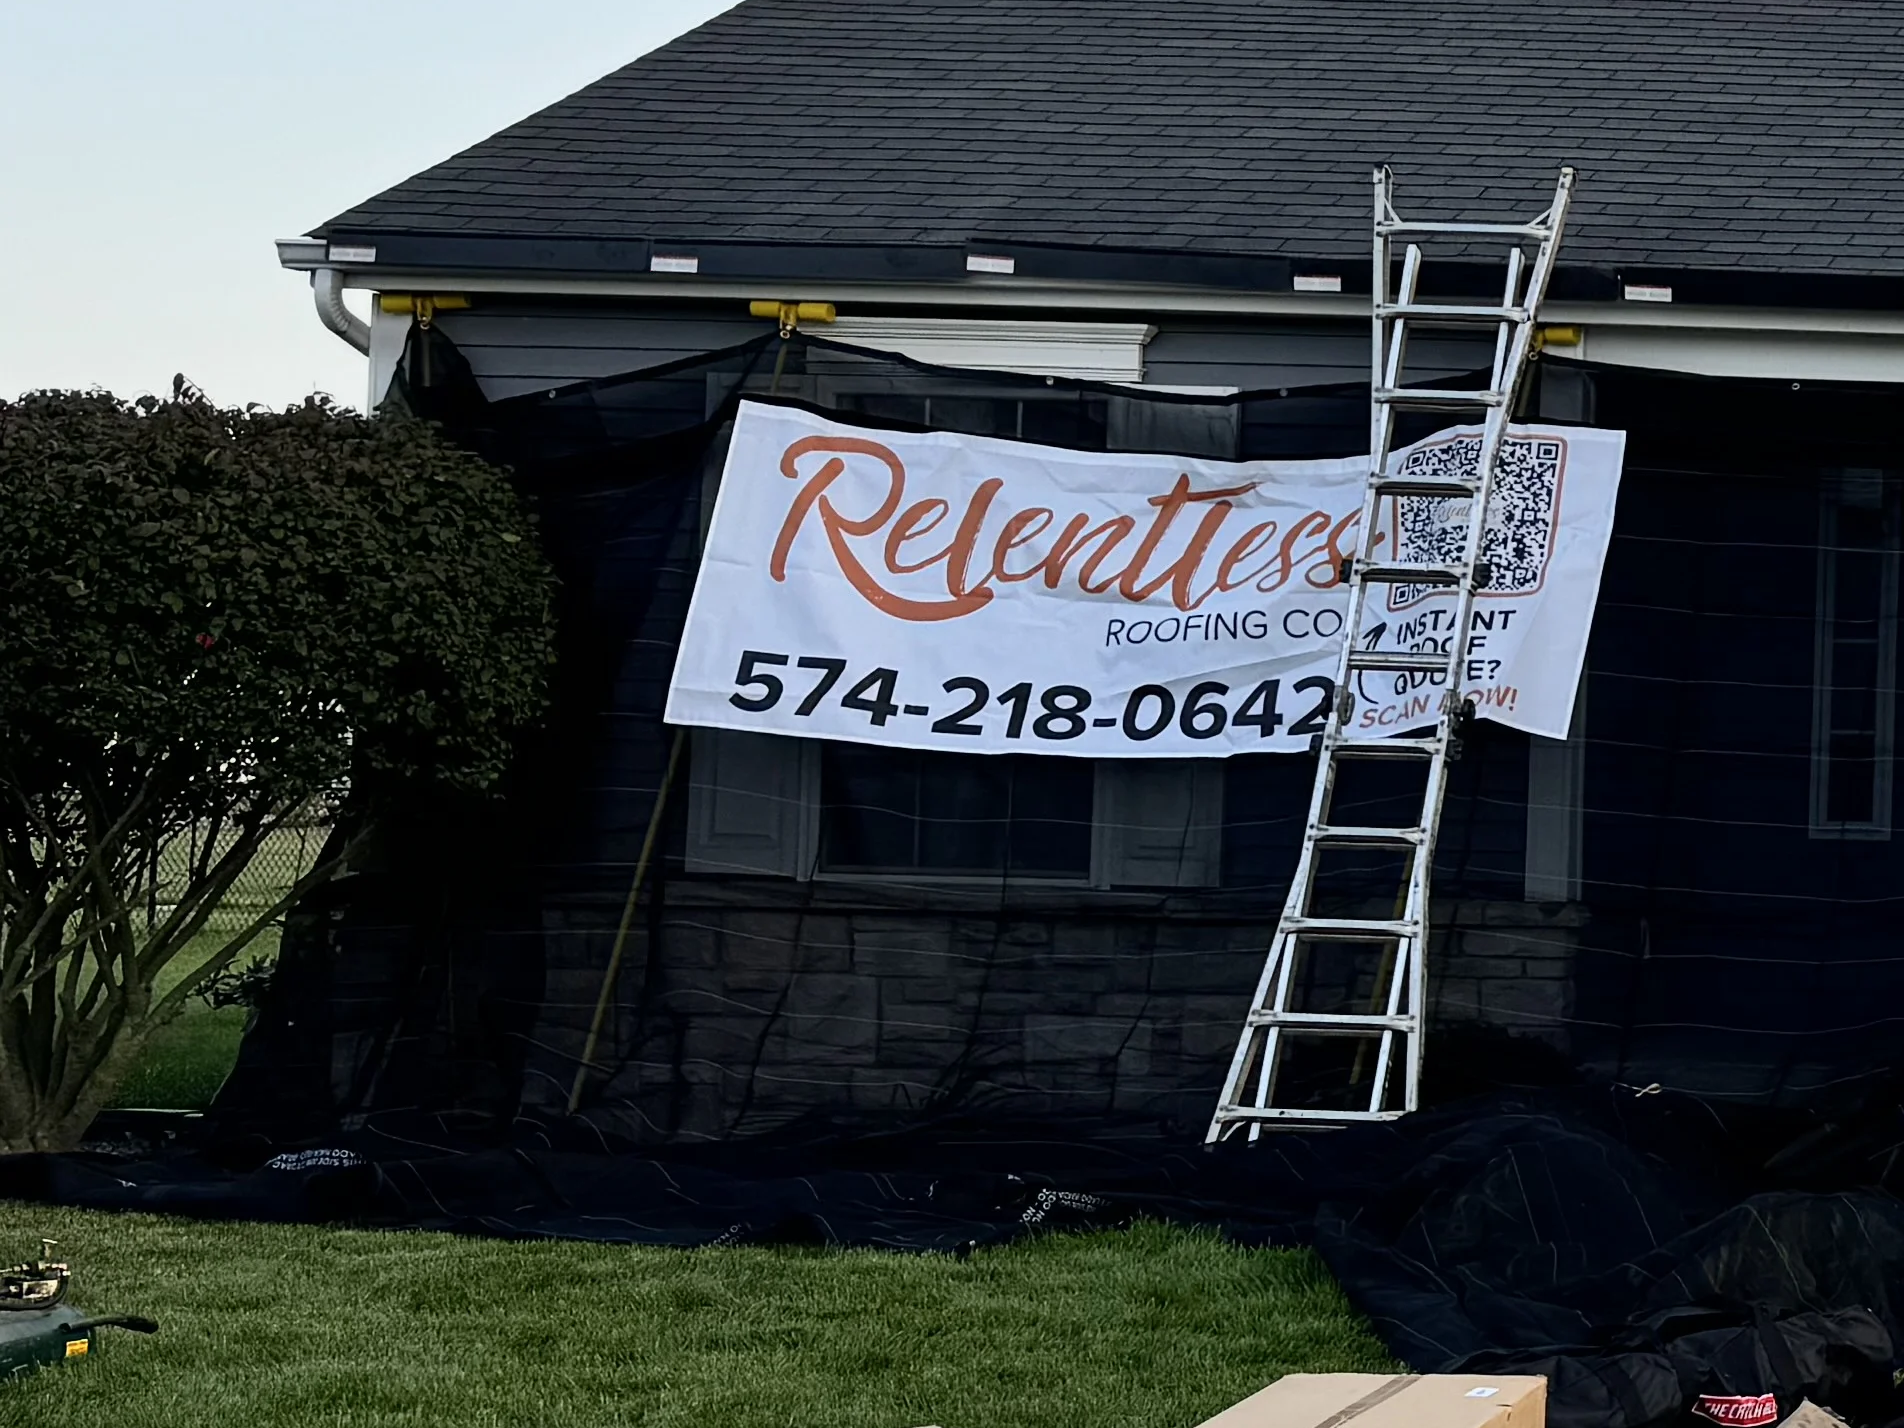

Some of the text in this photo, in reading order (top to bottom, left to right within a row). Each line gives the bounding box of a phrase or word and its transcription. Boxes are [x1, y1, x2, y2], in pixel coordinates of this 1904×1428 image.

[768, 434, 1386, 621] Relentless
[1105, 611, 1268, 647] ROOFING
[726, 649, 1337, 741] 574-218-0642
[1394, 660, 1502, 696] QUOE?
[1359, 693, 1431, 729] SCAN
